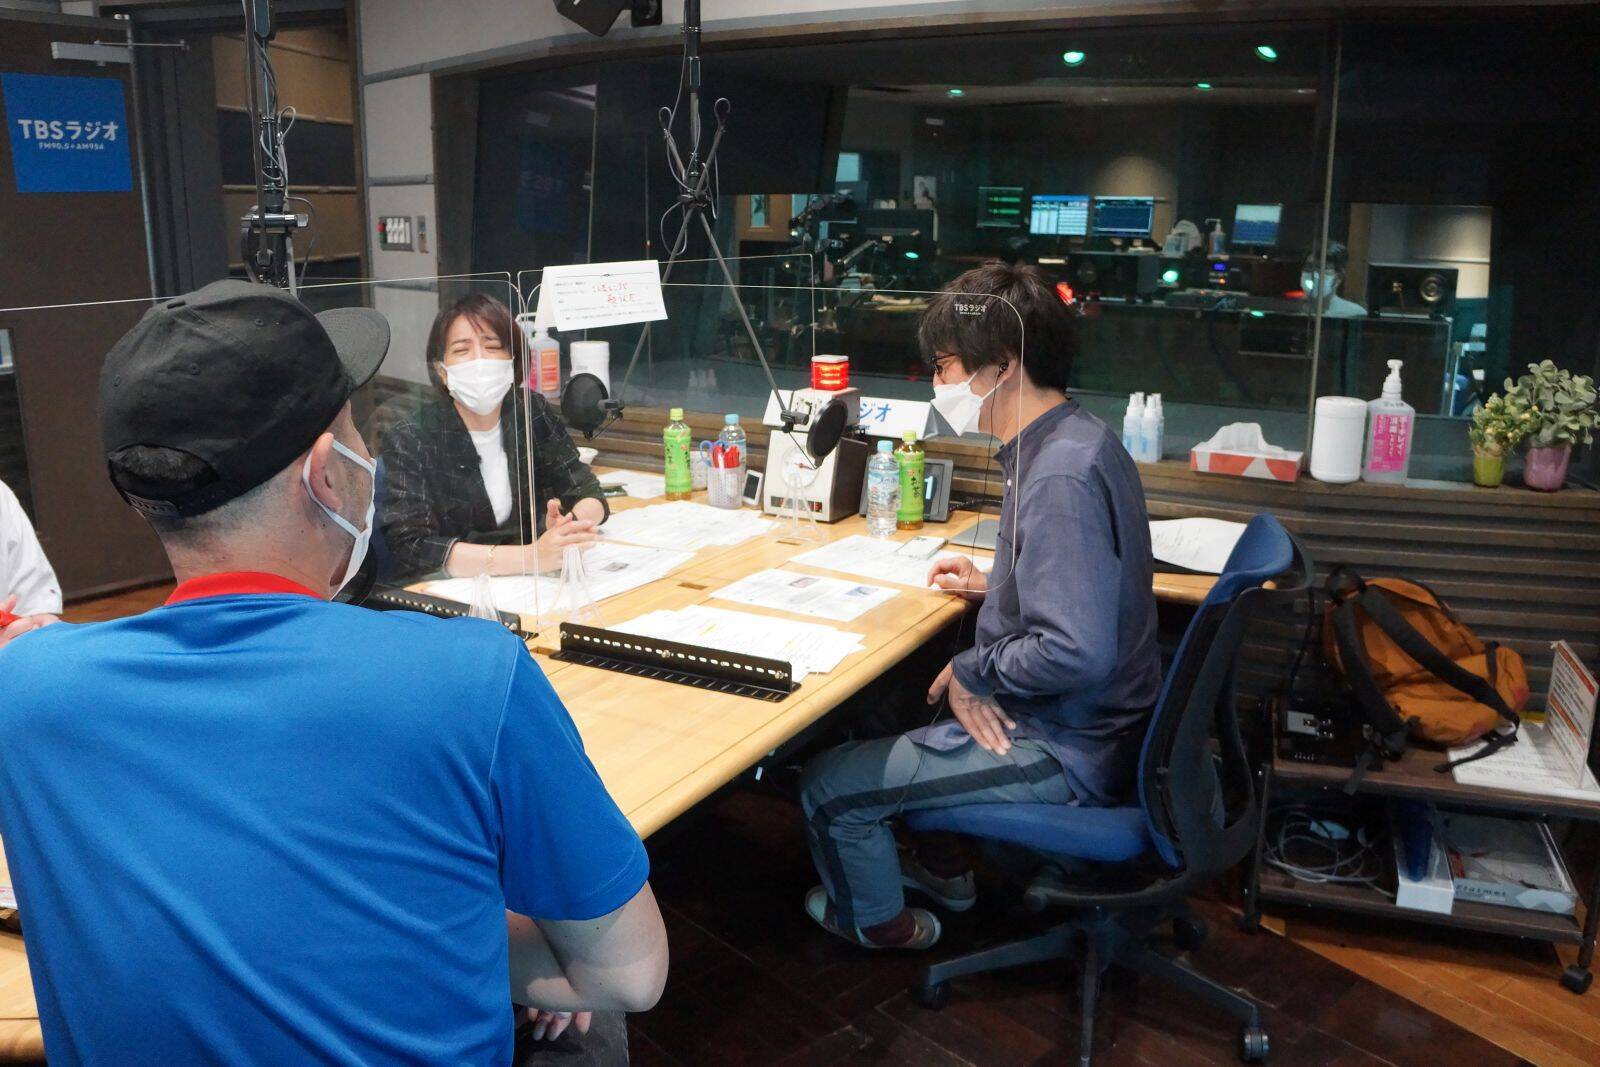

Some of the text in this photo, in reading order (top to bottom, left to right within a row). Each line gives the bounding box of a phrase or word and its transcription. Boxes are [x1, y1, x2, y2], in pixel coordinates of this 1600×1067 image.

[17, 119, 118, 141] TBSラジオ
[954, 303, 987, 313] TBSラジオ
